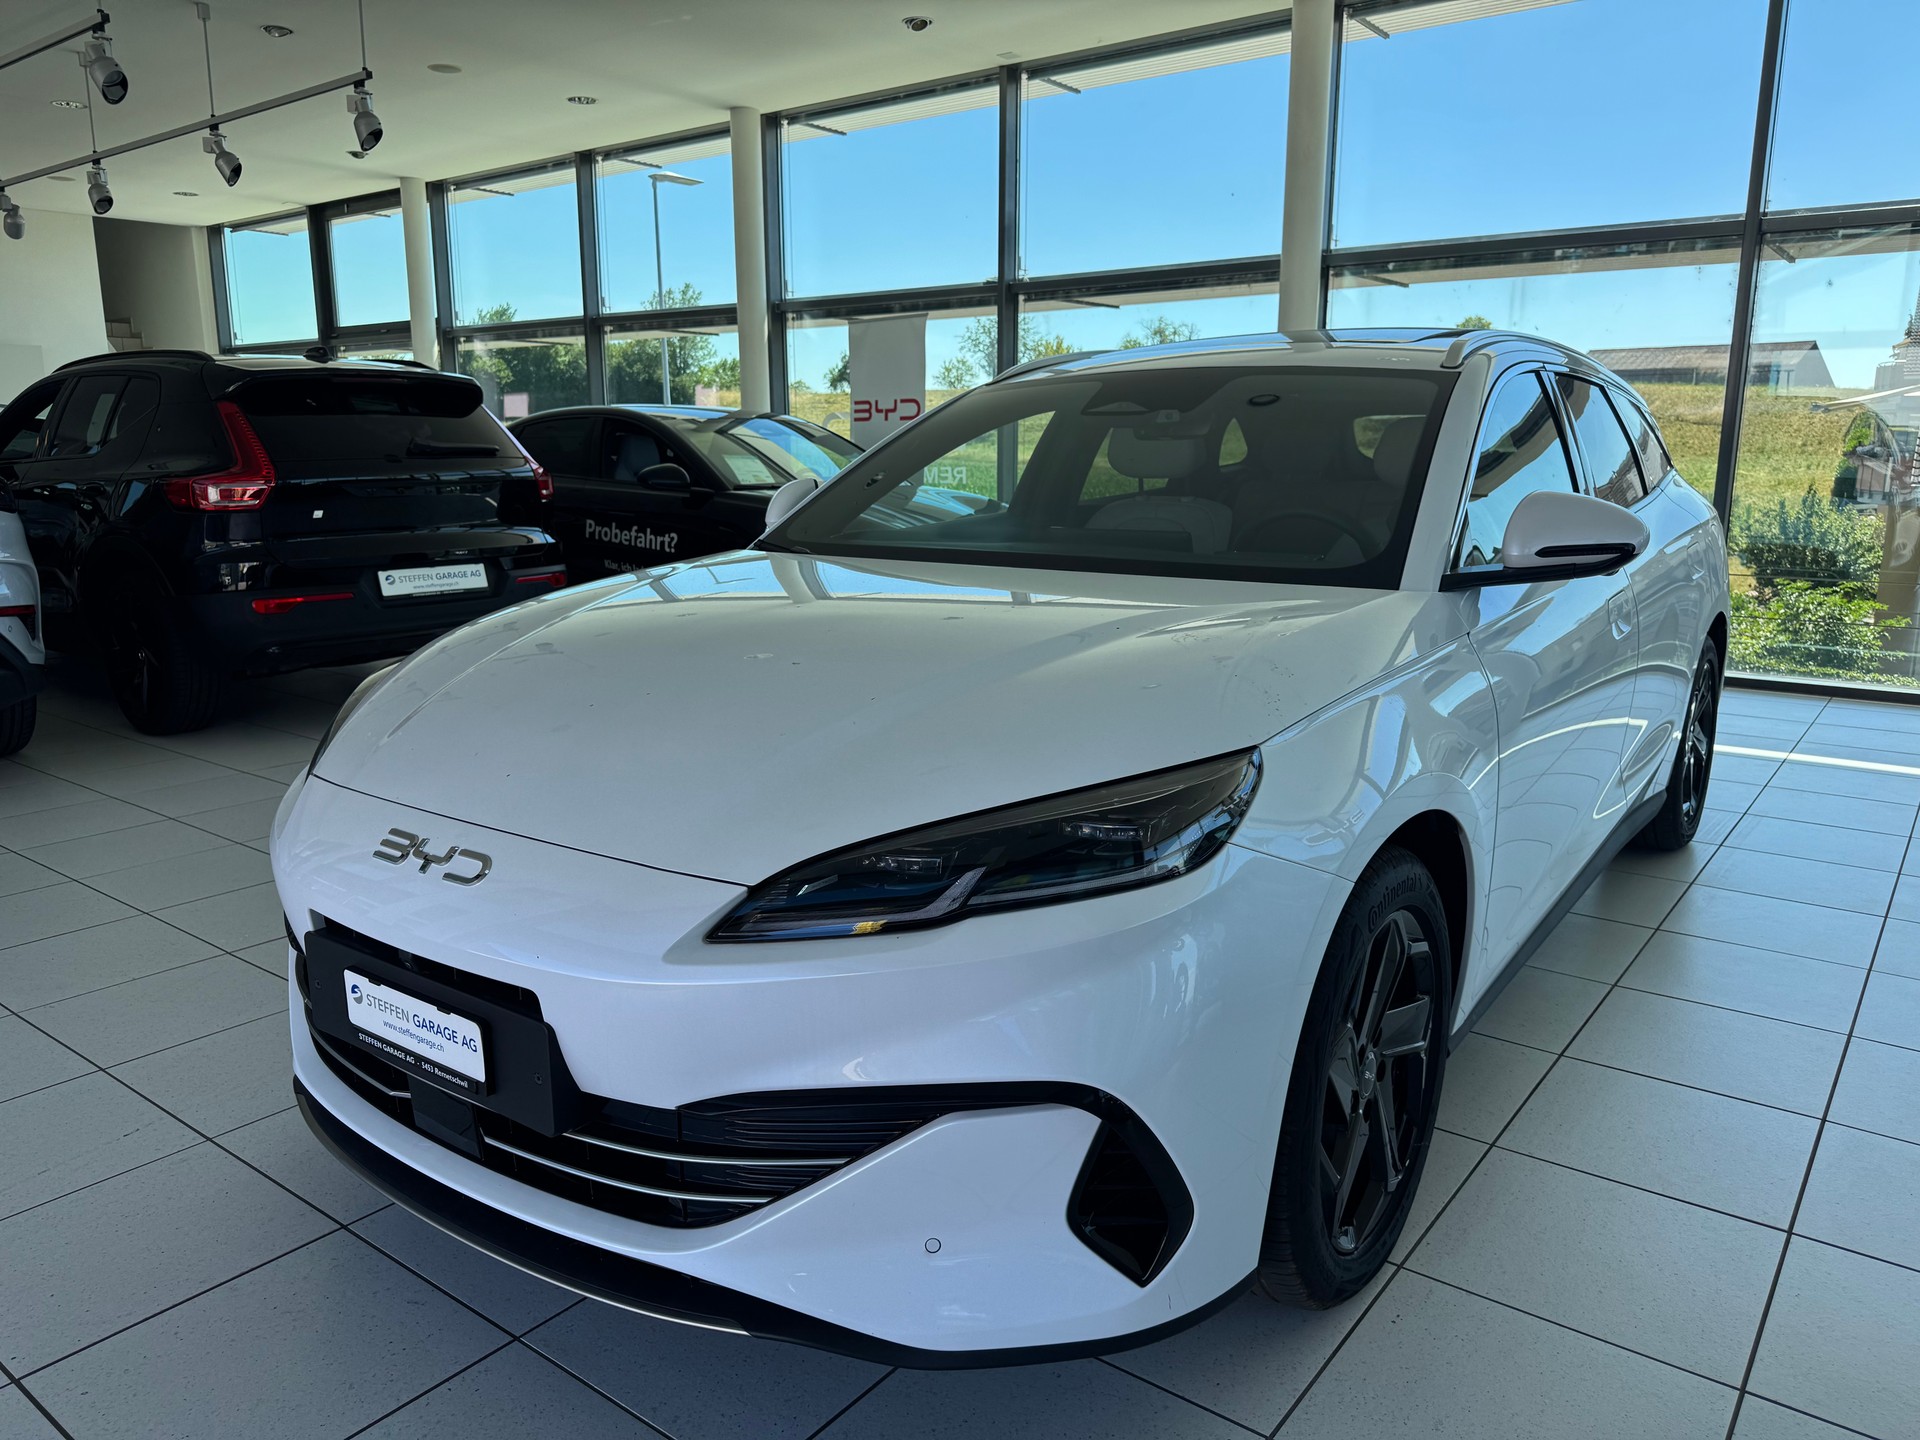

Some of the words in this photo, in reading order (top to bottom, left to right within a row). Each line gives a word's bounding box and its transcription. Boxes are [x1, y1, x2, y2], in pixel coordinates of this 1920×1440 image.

[853, 398, 921, 422] BYD
[585, 519, 678, 553] Probefahrt?
[398, 574, 434, 584] STEFFEN
[435, 571, 468, 581] GARAGE
[470, 569, 482, 578] AG
[372, 827, 493, 888] BYD
[366, 993, 410, 1024] STEFFEN
[412, 1013, 459, 1045] GARAGE
[461, 1035, 478, 1053] AG
[383, 1019, 445, 1053] www.steffengarage.ch
[358, 1032, 382, 1050] STEFFEN
[382, 1043, 406, 1061] GARAGE
[406, 1054, 415, 1065] AG
